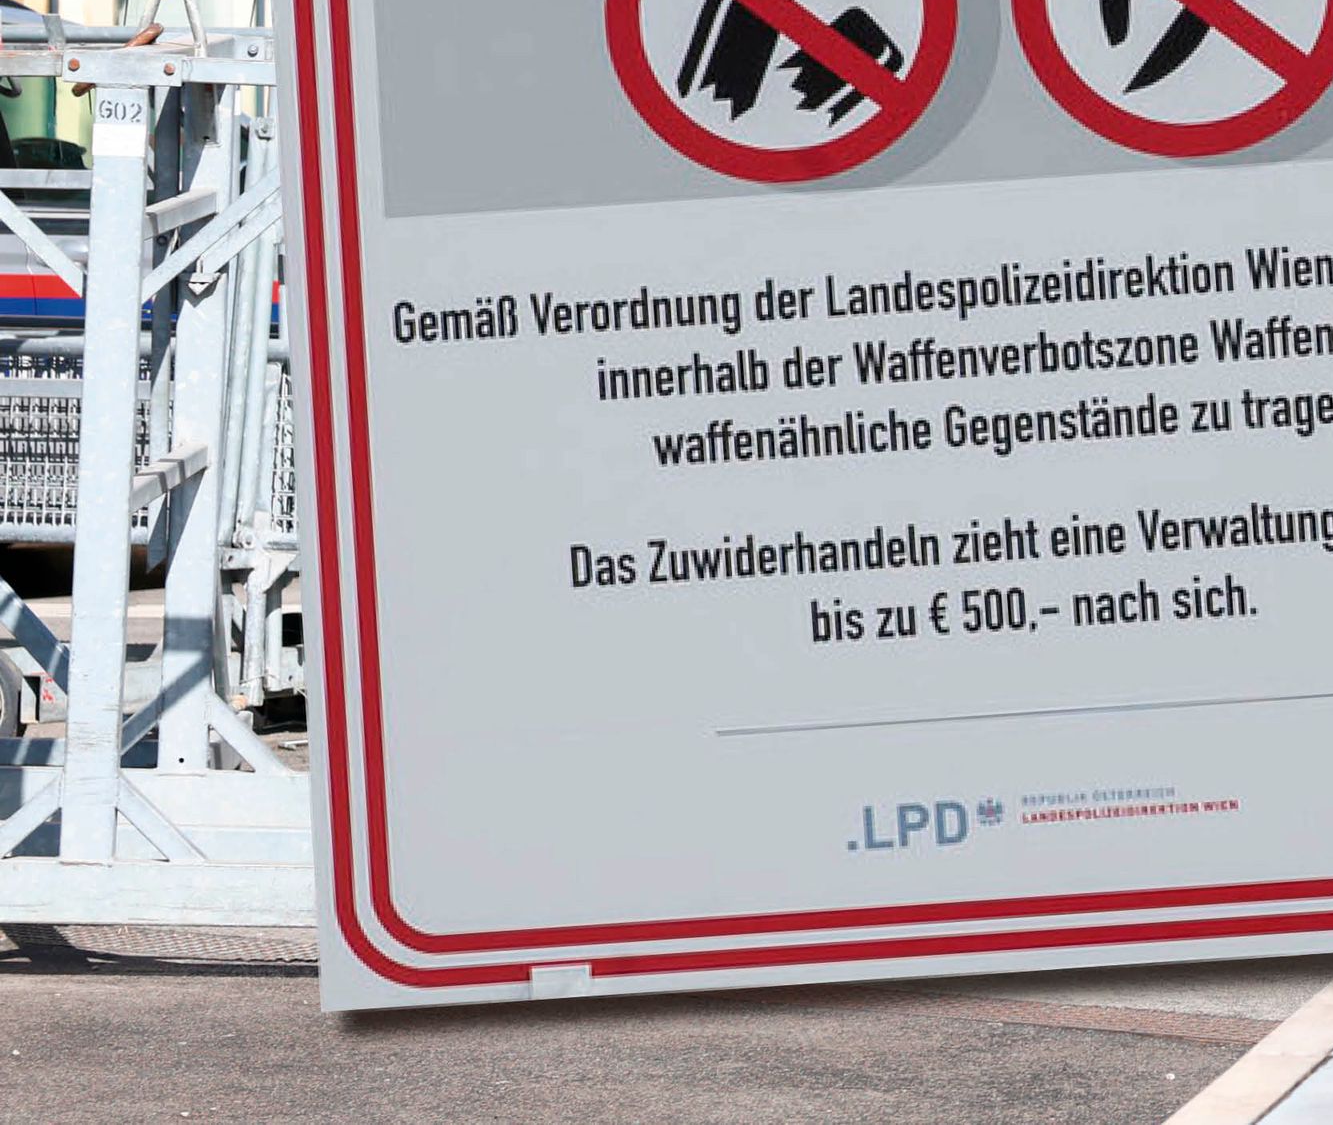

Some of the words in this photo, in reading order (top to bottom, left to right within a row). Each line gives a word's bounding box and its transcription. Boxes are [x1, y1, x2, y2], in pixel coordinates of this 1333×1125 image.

[394, 295, 518, 343] Gemäß
[530, 286, 741, 335] Verordnung
[755, 279, 814, 321] der
[826, 253, 1234, 320] Landespolizeidirektion
[597, 349, 769, 400] innerhalb
[783, 346, 842, 389] der
[853, 332, 1198, 384] Waffenverbotszone
[654, 409, 931, 465] waffenähnliche
[945, 393, 1178, 457] Gegenstände
[1191, 400, 1230, 433] zu
[571, 545, 636, 587] Das
[648, 524, 939, 582] Zuwiderhandeln
[952, 518, 1039, 563] zieht
[1051, 515, 1126, 557] eine
[811, 599, 864, 642] bis
[877, 606, 916, 639] zu
[929, 592, 950, 635] €
[1073, 579, 1159, 626] nach
[1173, 573, 1256, 619] sich.
[848, 801, 968, 851] .LPD
